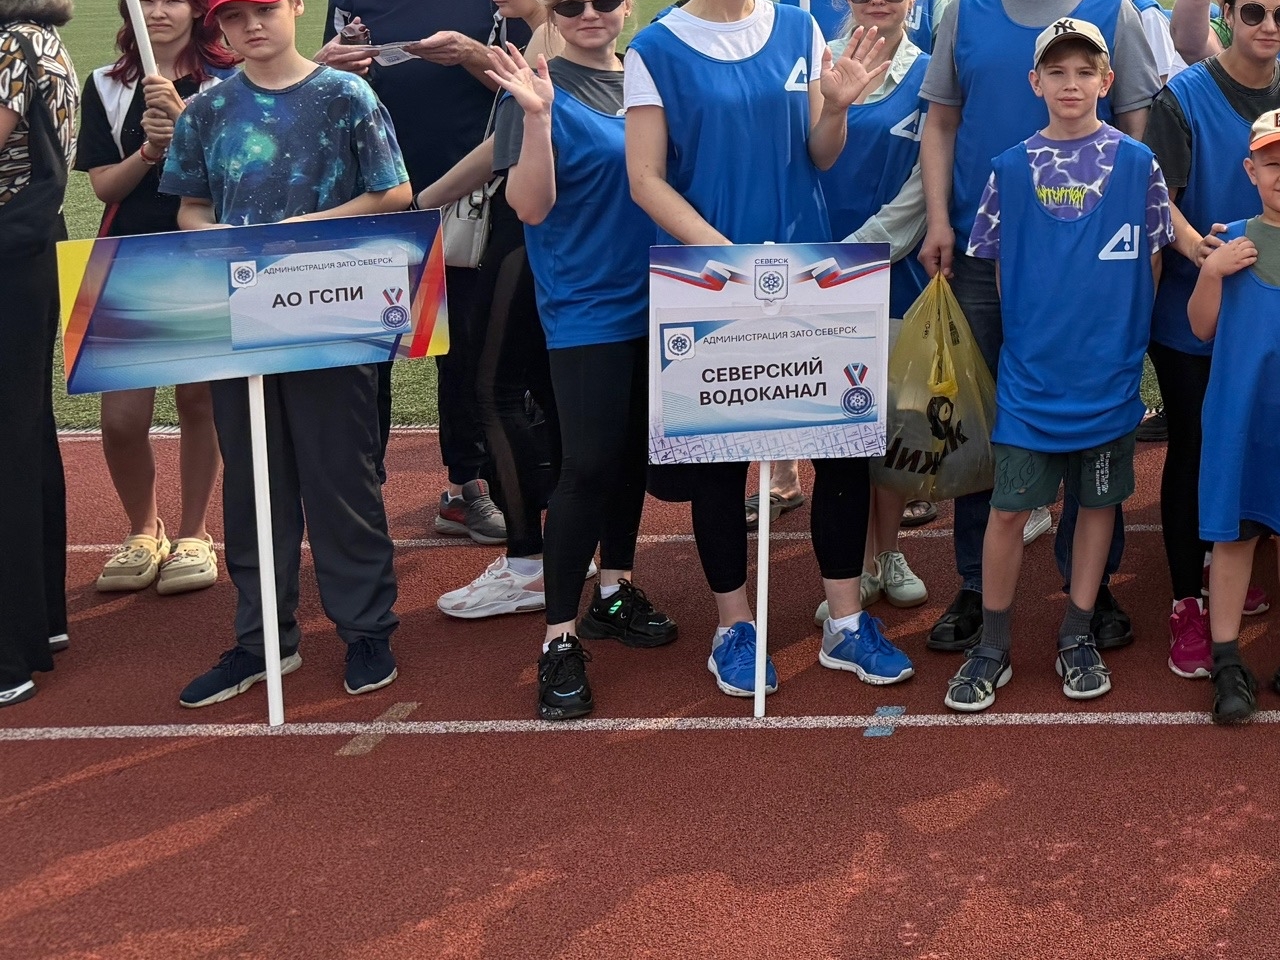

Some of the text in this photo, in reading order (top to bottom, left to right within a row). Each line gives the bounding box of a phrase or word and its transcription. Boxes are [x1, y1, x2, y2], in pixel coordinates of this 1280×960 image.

[263, 257, 393, 275] АДМИНИСТРАЦИЯ ЗАТО СЕВЕРСК
[272, 286, 364, 309] АО ГСПИ
[703, 326, 857, 345] АДМИНИСТРАЦИЯ ЗАТО СЕВЕРСК
[701, 356, 823, 383] СЕВЕРСКИЙ
[699, 382, 827, 406] ВОДОКАНАЛ
